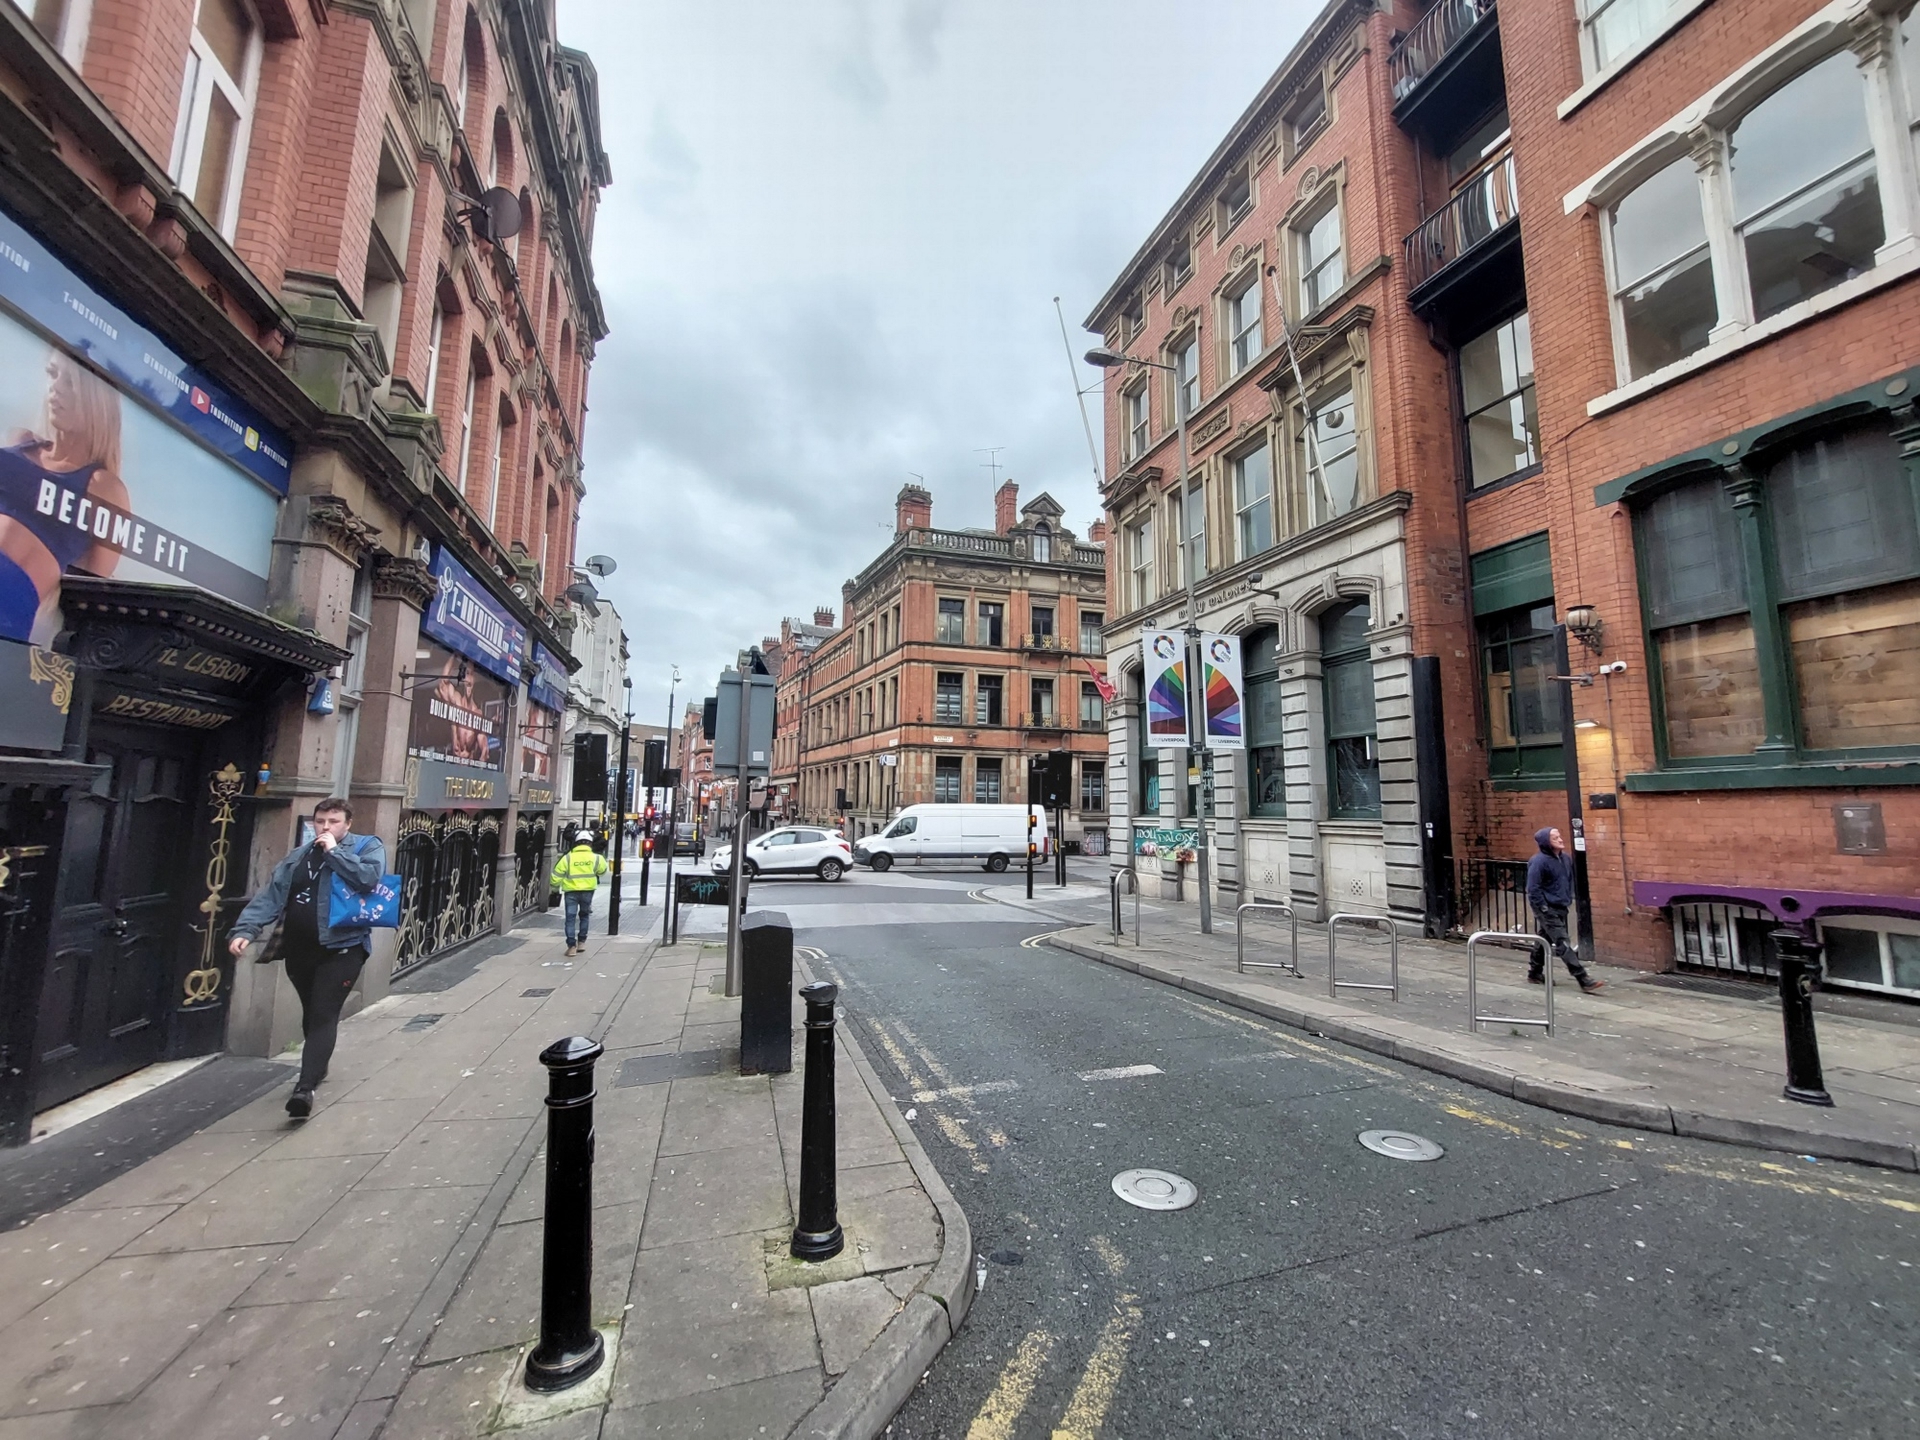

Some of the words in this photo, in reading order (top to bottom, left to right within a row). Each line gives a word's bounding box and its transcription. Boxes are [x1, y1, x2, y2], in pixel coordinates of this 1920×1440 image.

[63, 290, 118, 341] T-NUTRITION
[36, 478, 146, 555] BECOME
[154, 533, 189, 573] FIT
[451, 586, 504, 648] T-NUTRITION
[183, 651, 251, 684] LISBON
[101, 695, 233, 730] RESTAURANT
[430, 698, 448, 719] BUILD
[448, 706, 468, 726] MUSCLE
[473, 715, 482, 731] GET
[445, 776, 464, 798] THE
[464, 778, 494, 800] LISBON
